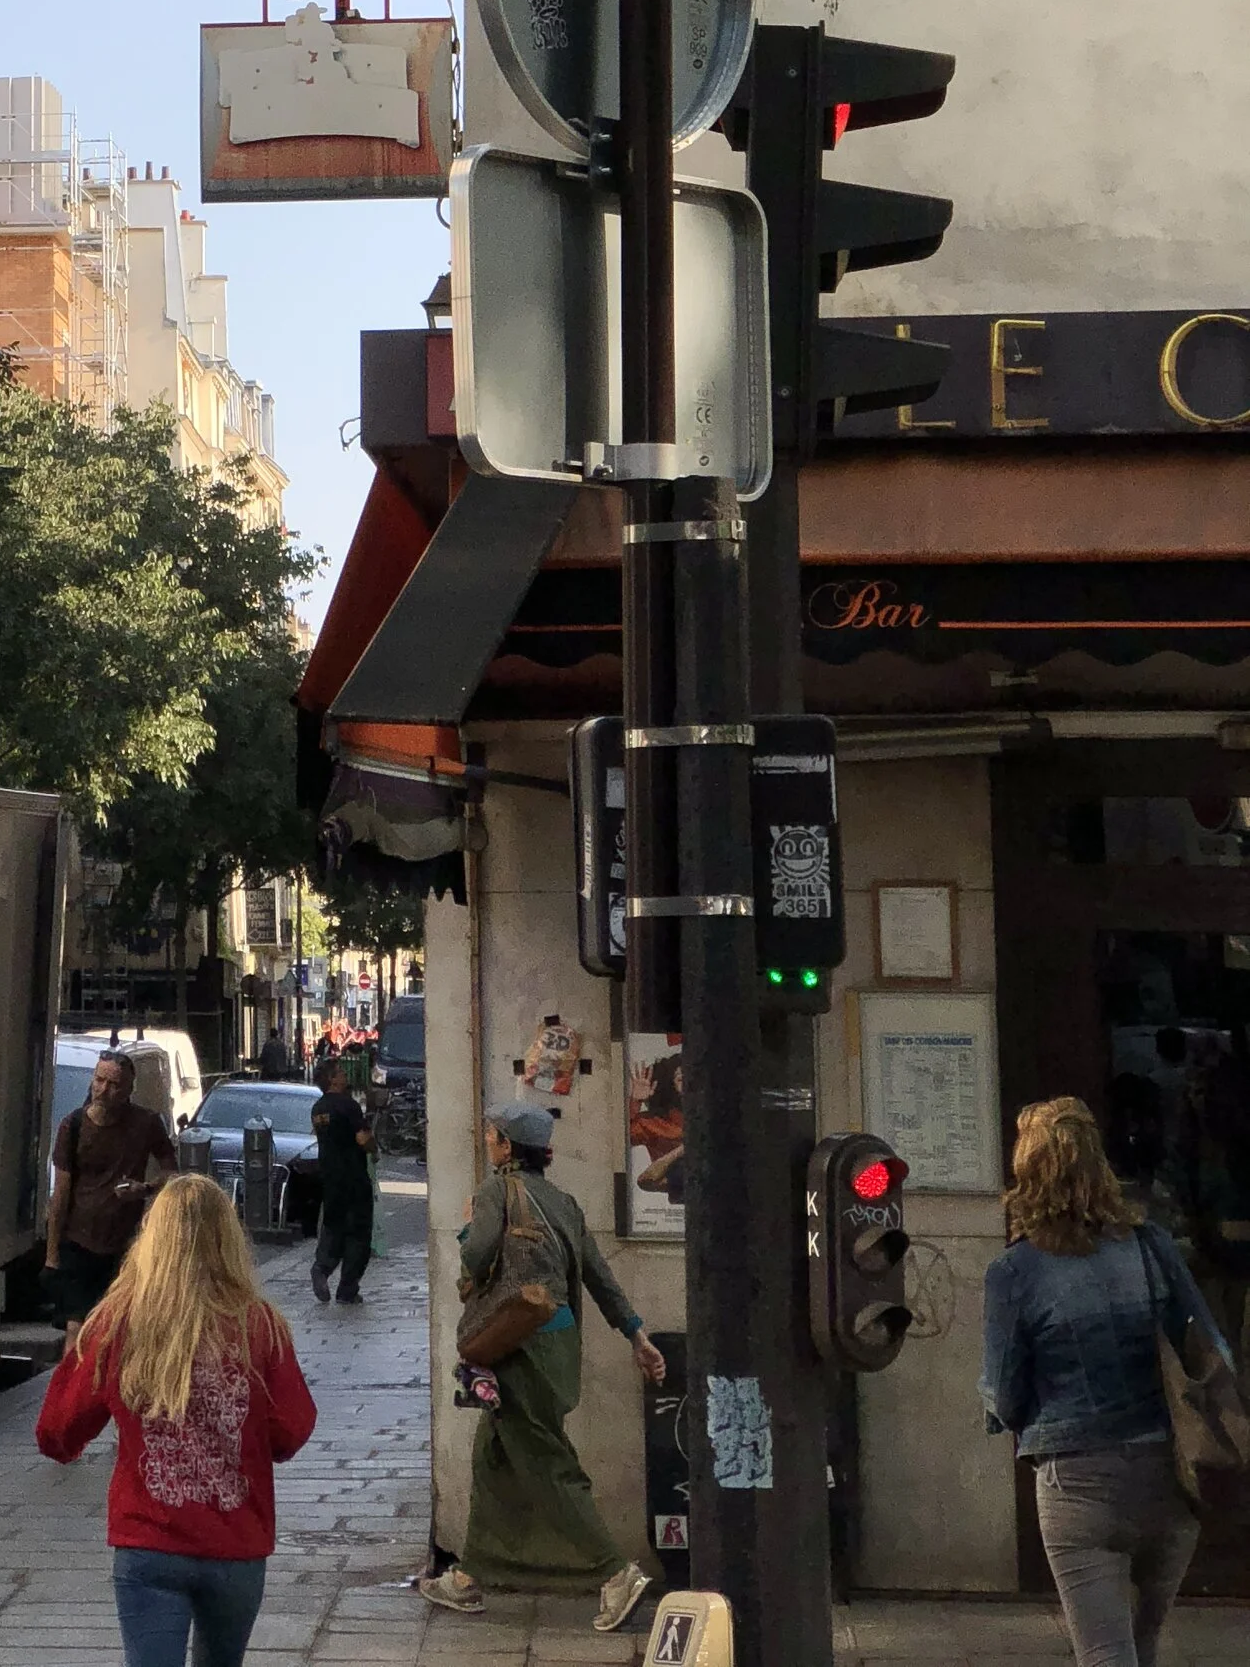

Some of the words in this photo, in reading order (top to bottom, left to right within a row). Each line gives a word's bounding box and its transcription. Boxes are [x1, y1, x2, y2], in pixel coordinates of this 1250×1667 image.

[894, 319, 1050, 431] LE
[808, 579, 934, 631] Bar
[776, 883, 826, 897] SMILE
[785, 898, 818, 914] 365
[806, 1190, 819, 1217] K
[808, 1231, 820, 1258] K
